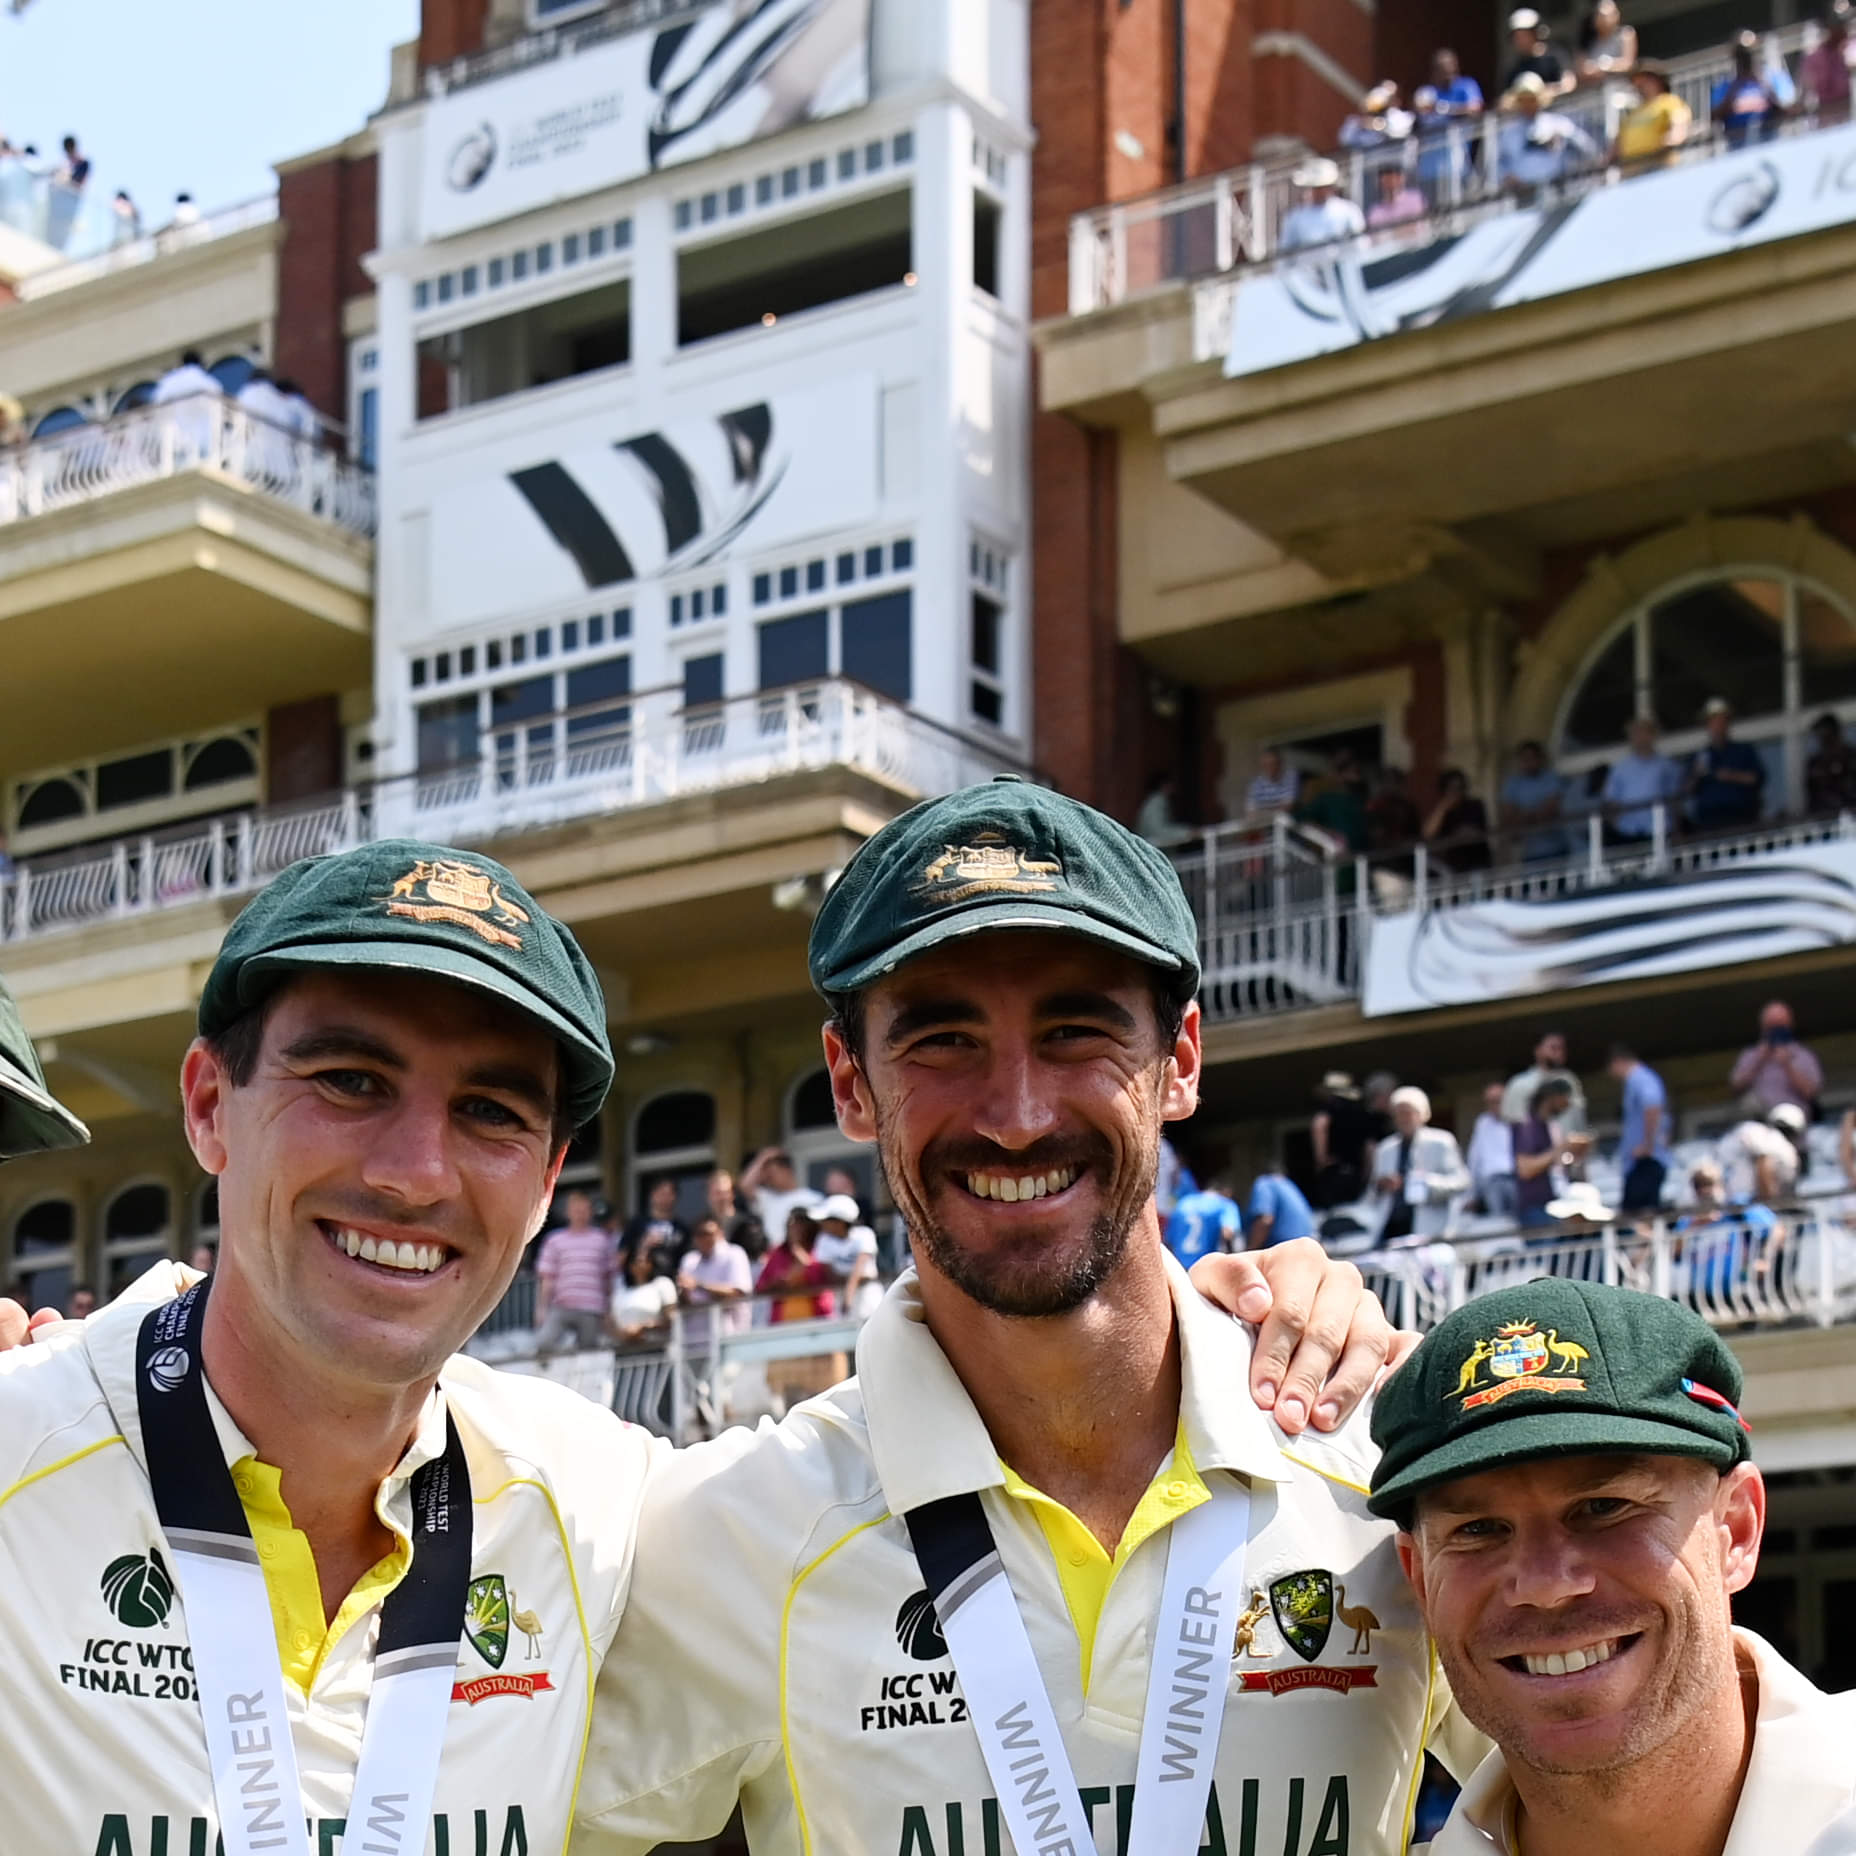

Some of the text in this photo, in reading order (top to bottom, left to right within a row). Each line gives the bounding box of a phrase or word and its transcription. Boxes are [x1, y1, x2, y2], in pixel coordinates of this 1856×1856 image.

[437, 1504, 449, 1532] TEST
[84, 1639, 131, 1665] ICC
[60, 1664, 150, 1697] FINAL
[468, 1678, 531, 1701] AUSTRALIA
[881, 1674, 924, 1700] ICC
[1159, 1586, 1222, 1783] WINNER
[1273, 1669, 1347, 1691] AUSTRALIA
[861, 1701, 945, 1731] FINAL
